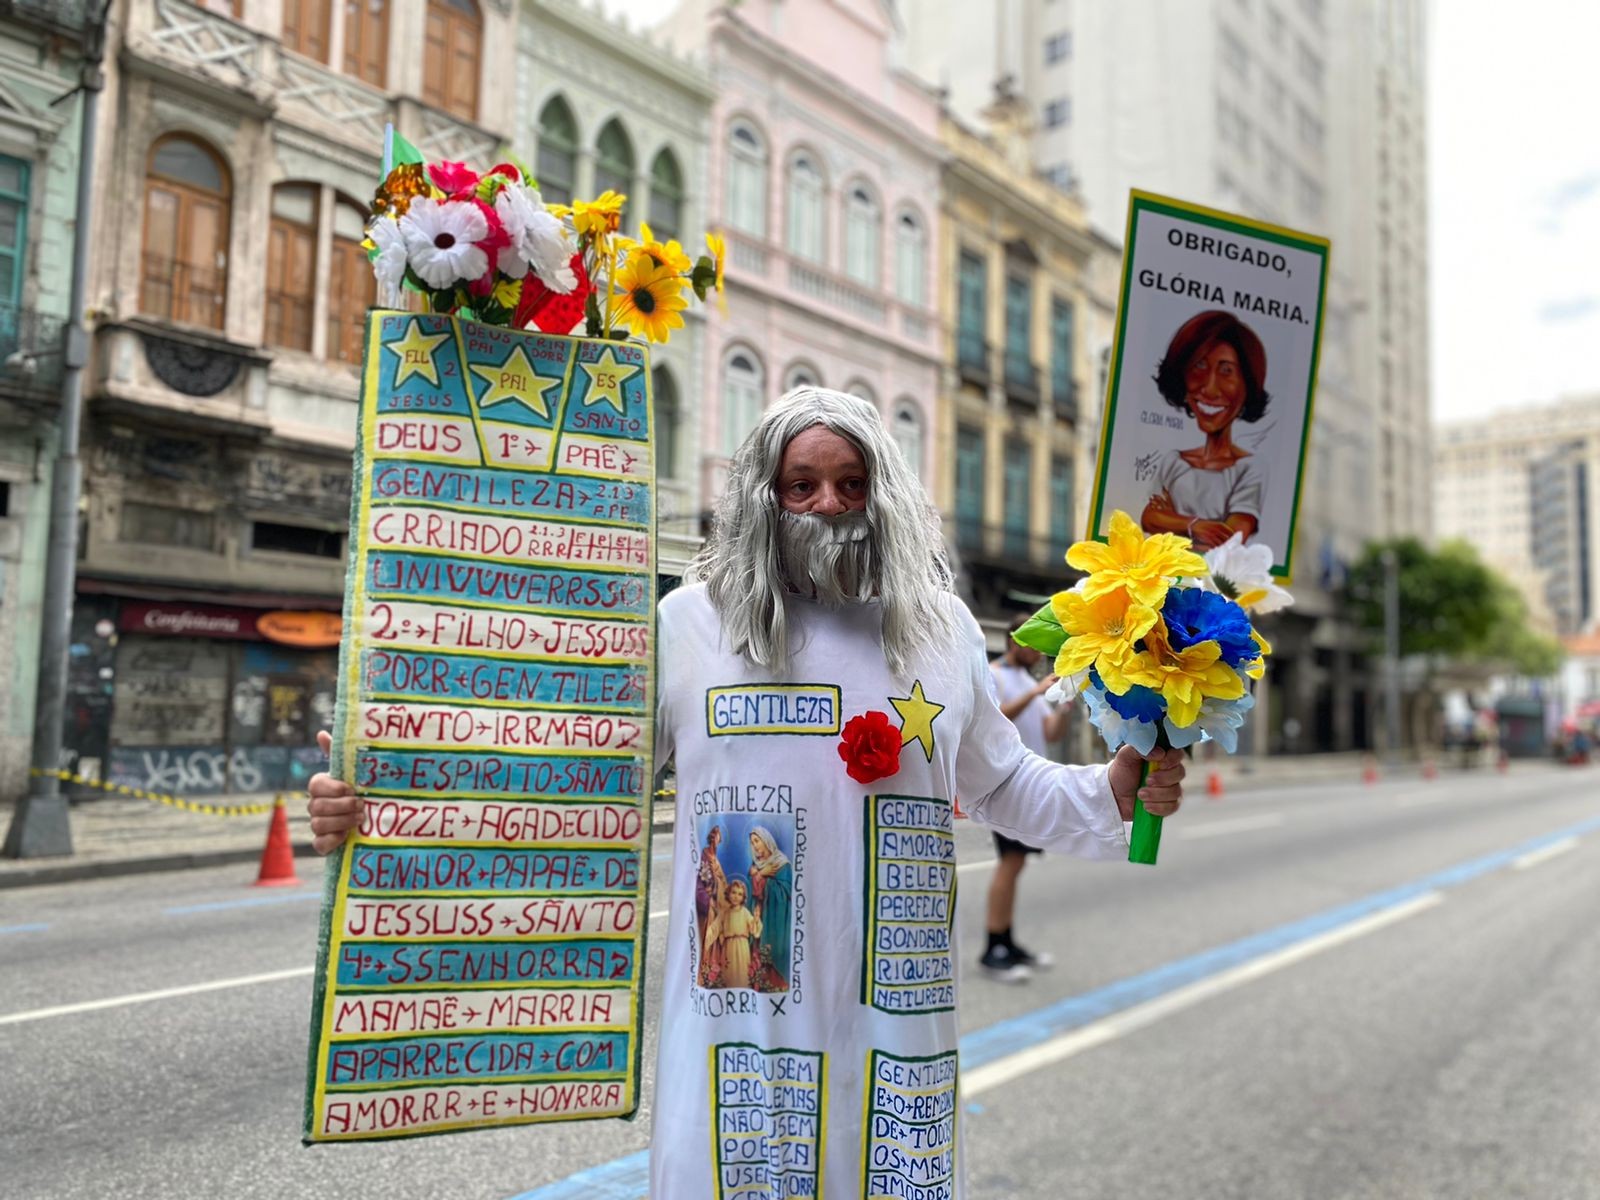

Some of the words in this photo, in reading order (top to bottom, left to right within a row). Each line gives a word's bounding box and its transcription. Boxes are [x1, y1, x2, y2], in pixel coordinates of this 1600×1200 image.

[1168, 228, 1292, 278] OBRIGADO,
[1139, 269, 1225, 304] GLÓRIA
[1233, 291, 1309, 326] MARIA.
[444, 361, 457, 376] 2
[500, 372, 527, 391] PAI
[597, 373, 617, 389] ES
[389, 393, 453, 408] JESUS
[633, 391, 642, 404] 3
[573, 411, 640, 432] SANTO
[379, 423, 462, 453] DEUS
[376, 467, 574, 509] GENTILEZA
[374, 514, 523, 556] CRRIADO
[366, 651, 450, 693] PORR
[713, 693, 835, 729] GENTILEZA
[410, 758, 553, 792] ESPIRITO
[693, 784, 794, 816] GENTILEZA
[477, 805, 642, 842] AGADECIDO
[352, 852, 476, 888] SENHOR
[605, 858, 638, 888] DE
[879, 926, 948, 950] BONDADE
[878, 957, 949, 981] RIQUEZA
[486, 994, 612, 1026] MARRIA
[877, 985, 953, 1007] NATUREZA
[331, 1041, 534, 1082] APARRECIDA
[556, 1040, 614, 1072] COM
[722, 1049, 762, 1073] NÃO
[762, 1057, 814, 1082] USEM
[324, 1090, 462, 1133] AMORRR
[482, 1091, 498, 1116] E
[519, 1084, 621, 1115] HONRRA
[723, 1079, 816, 1112] PROLEMAS
[877, 1087, 887, 1107] E
[893, 1095, 906, 1114] O
[723, 1109, 764, 1133] NÃO
[876, 1116, 899, 1140] DE
[874, 1145, 901, 1169] OS
